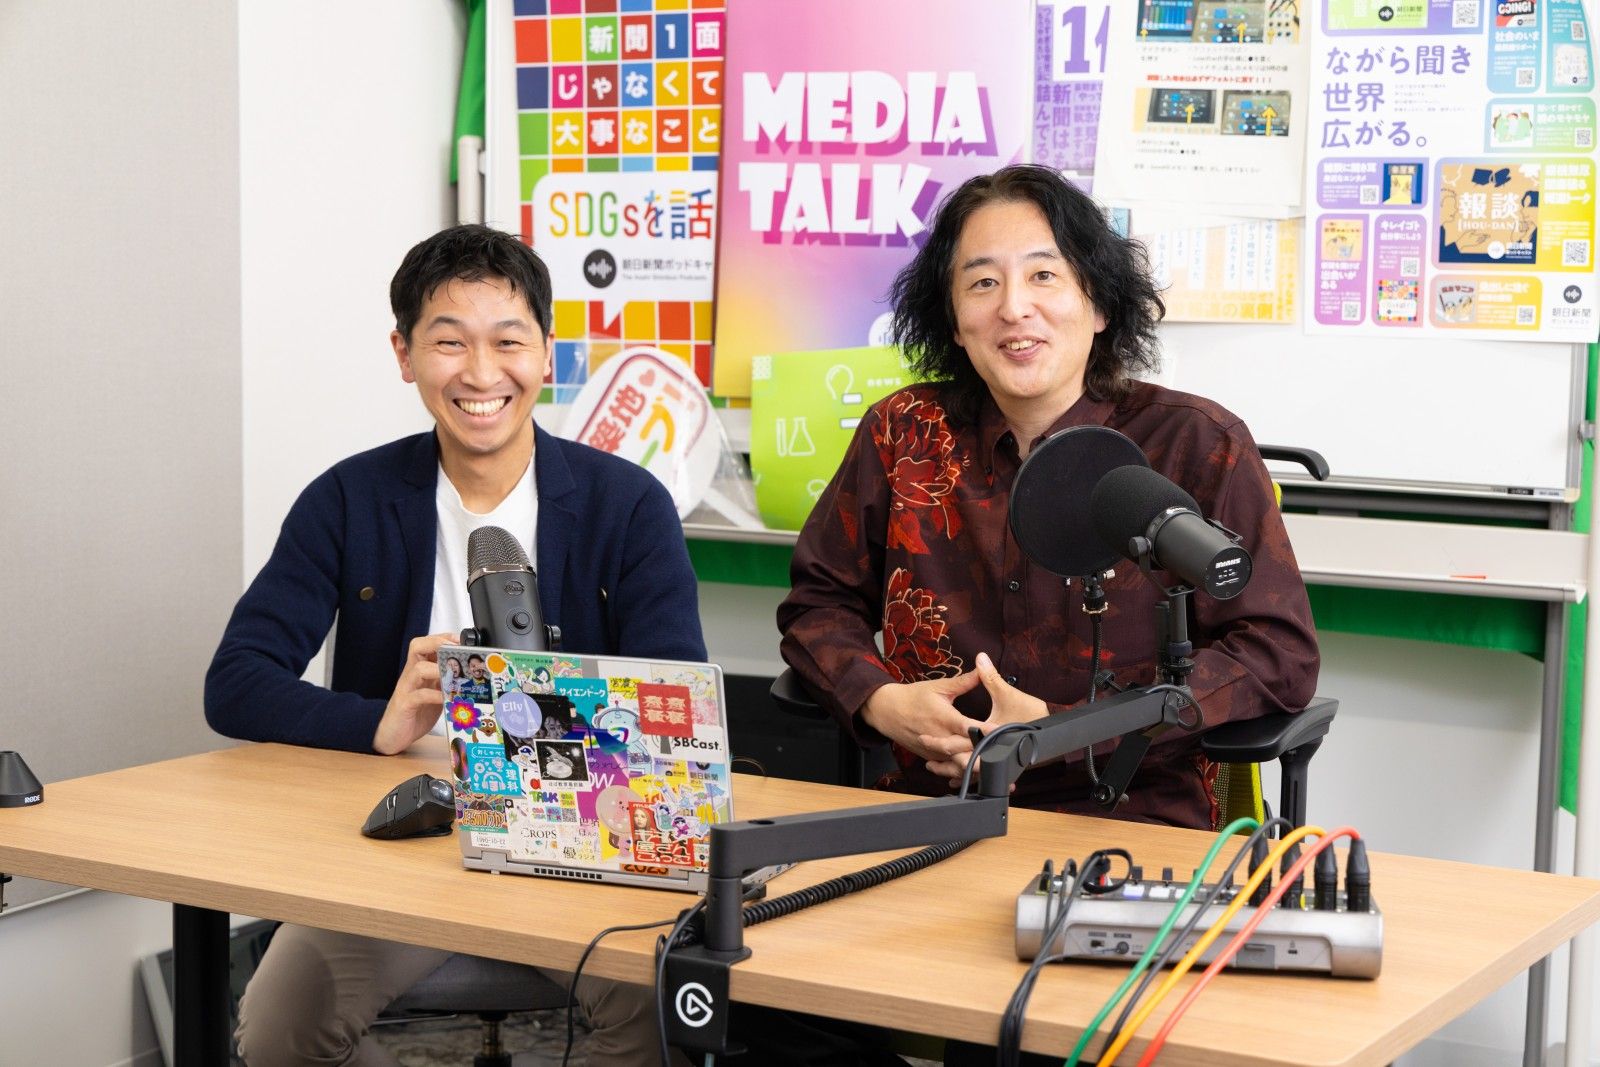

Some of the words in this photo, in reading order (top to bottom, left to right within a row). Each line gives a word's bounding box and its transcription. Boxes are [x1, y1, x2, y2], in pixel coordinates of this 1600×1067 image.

[588, 21, 721, 54] 新聞1面
[1326, 45, 1471, 75] ながら聞き
[557, 70, 720, 100] じゃなくて
[1323, 82, 1385, 112] 世界
[743, 71, 989, 145] MEDIA
[555, 117, 719, 147] 大事なこと
[1321, 119, 1427, 148] 広がる。
[739, 162, 932, 238] TALK
[1459, 192, 1520, 219] 報談
[1552, 307, 1592, 318] 朝日新聞
[867, 377, 902, 387] news
[502, 702, 523, 713] Elly
